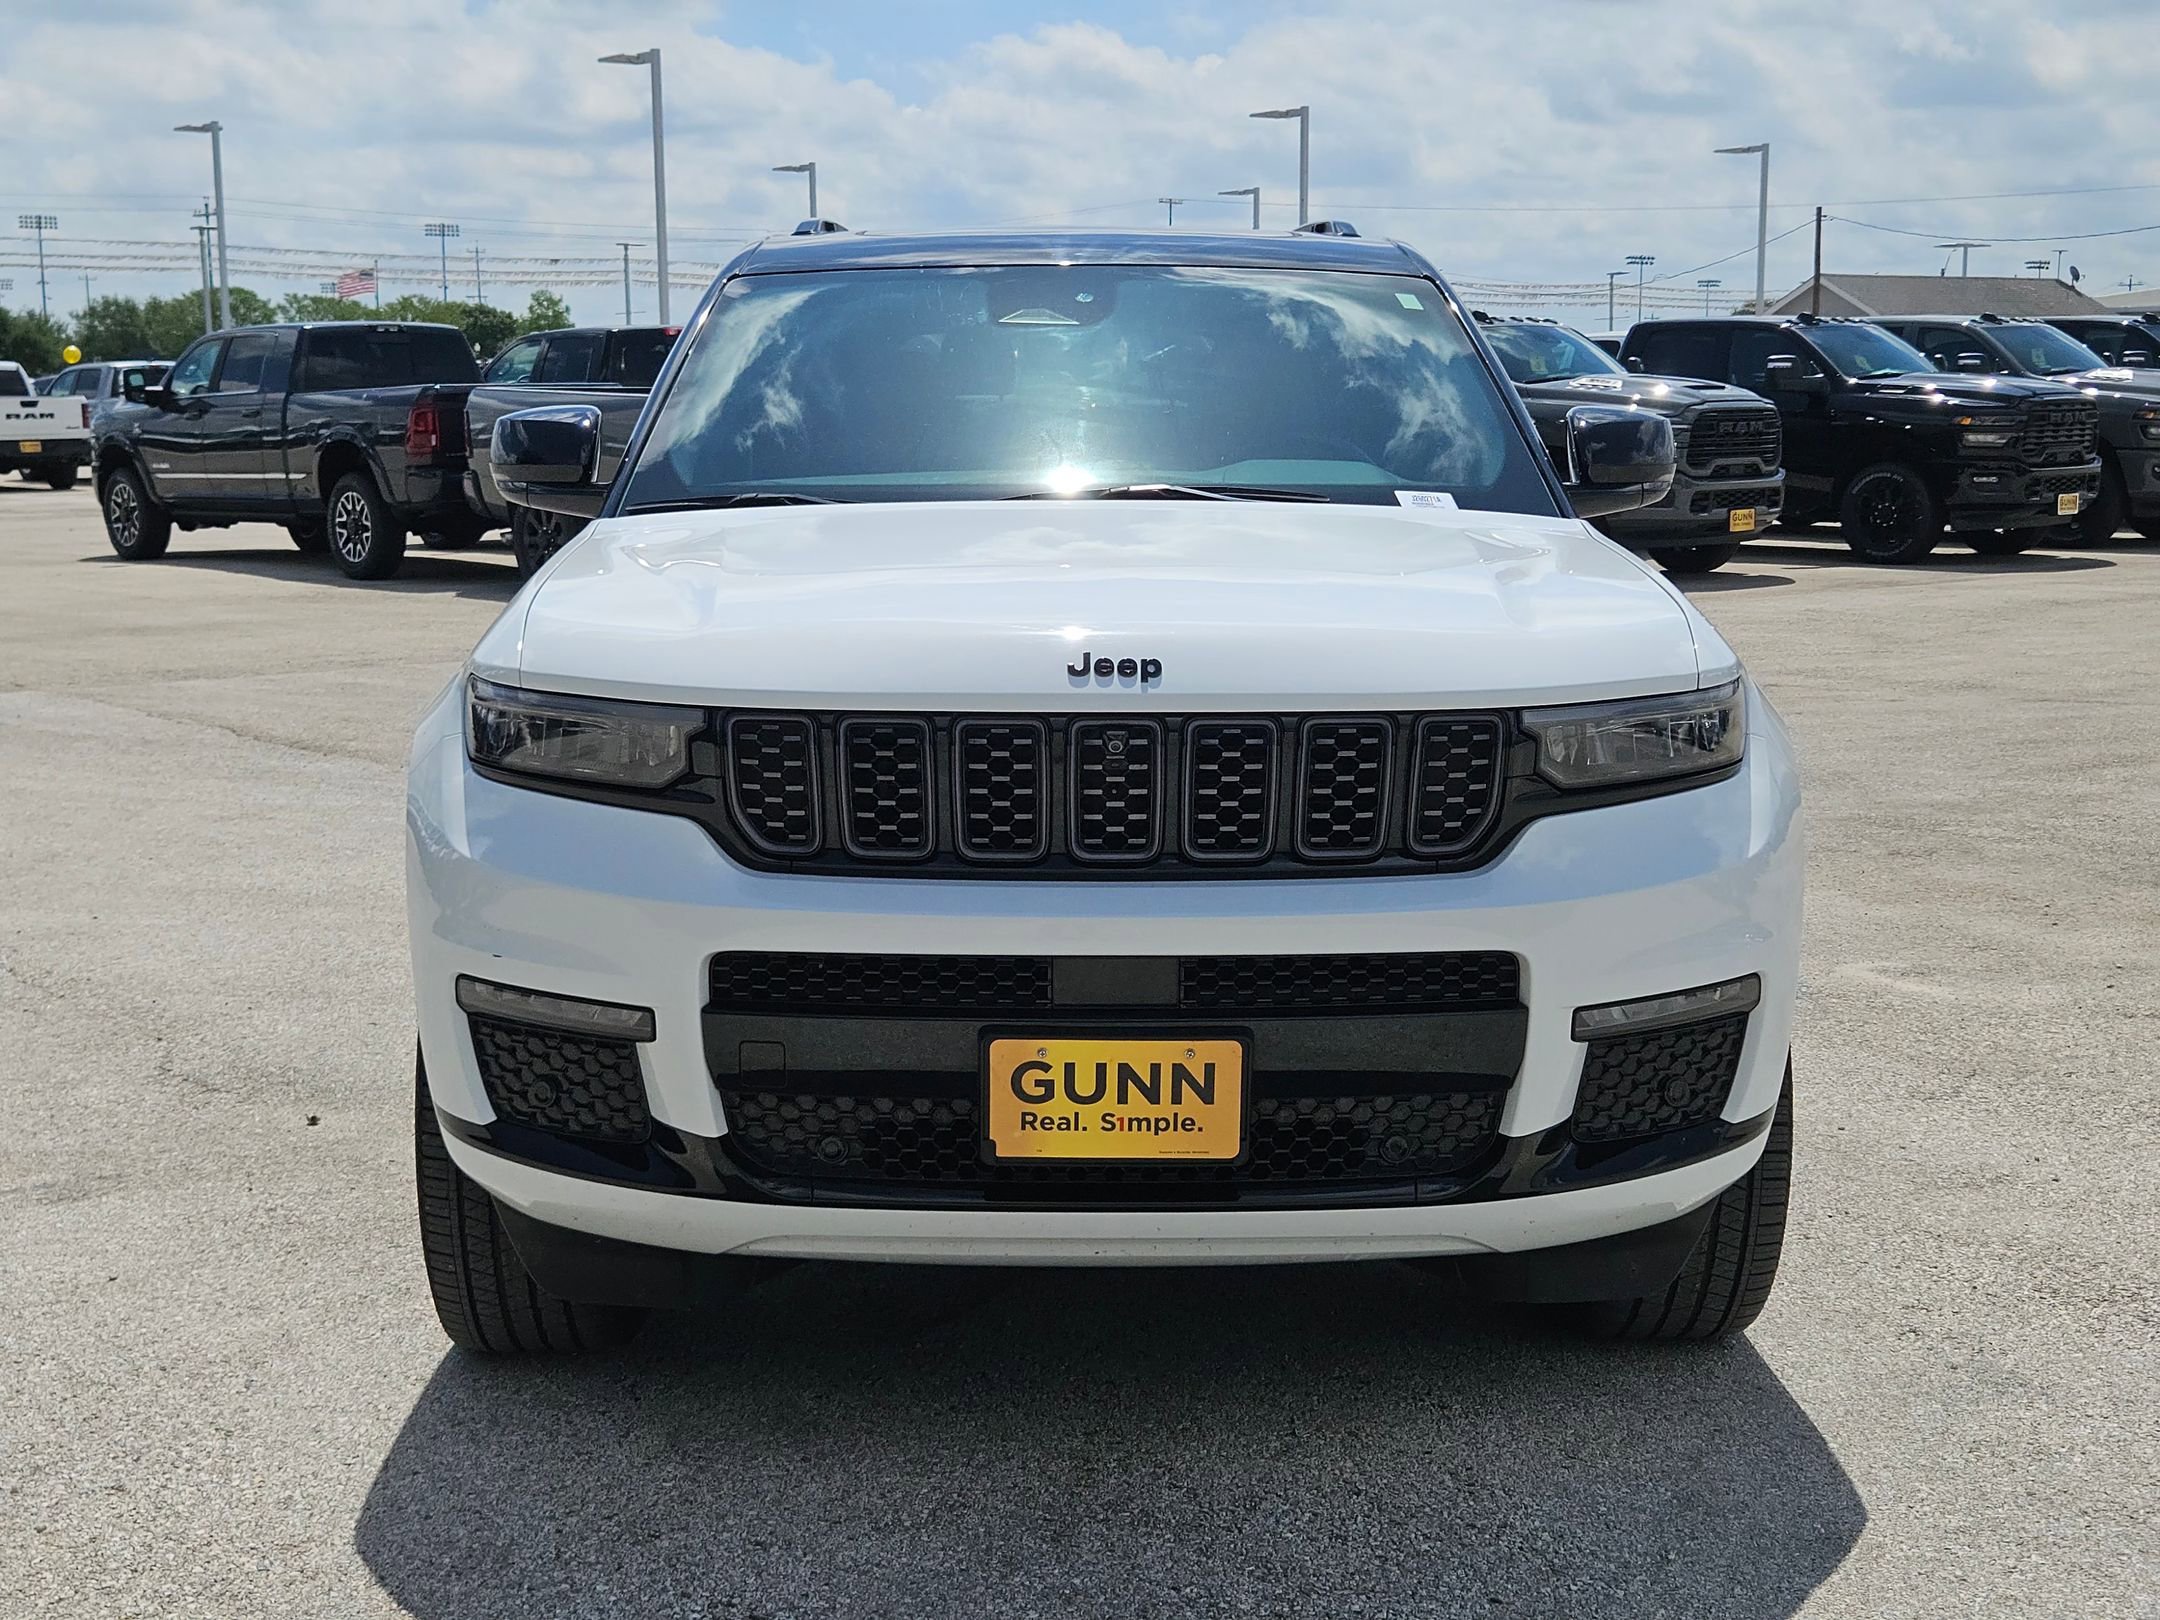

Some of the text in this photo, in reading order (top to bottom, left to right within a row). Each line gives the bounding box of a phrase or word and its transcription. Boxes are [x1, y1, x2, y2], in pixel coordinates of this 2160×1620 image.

[1719, 421, 1763, 433] RAM
[1732, 512, 1753, 522] GUNN
[1067, 652, 1162, 683] Jeep
[1010, 1061, 1216, 1105] GUNN
[1020, 1111, 1088, 1132] Real.
